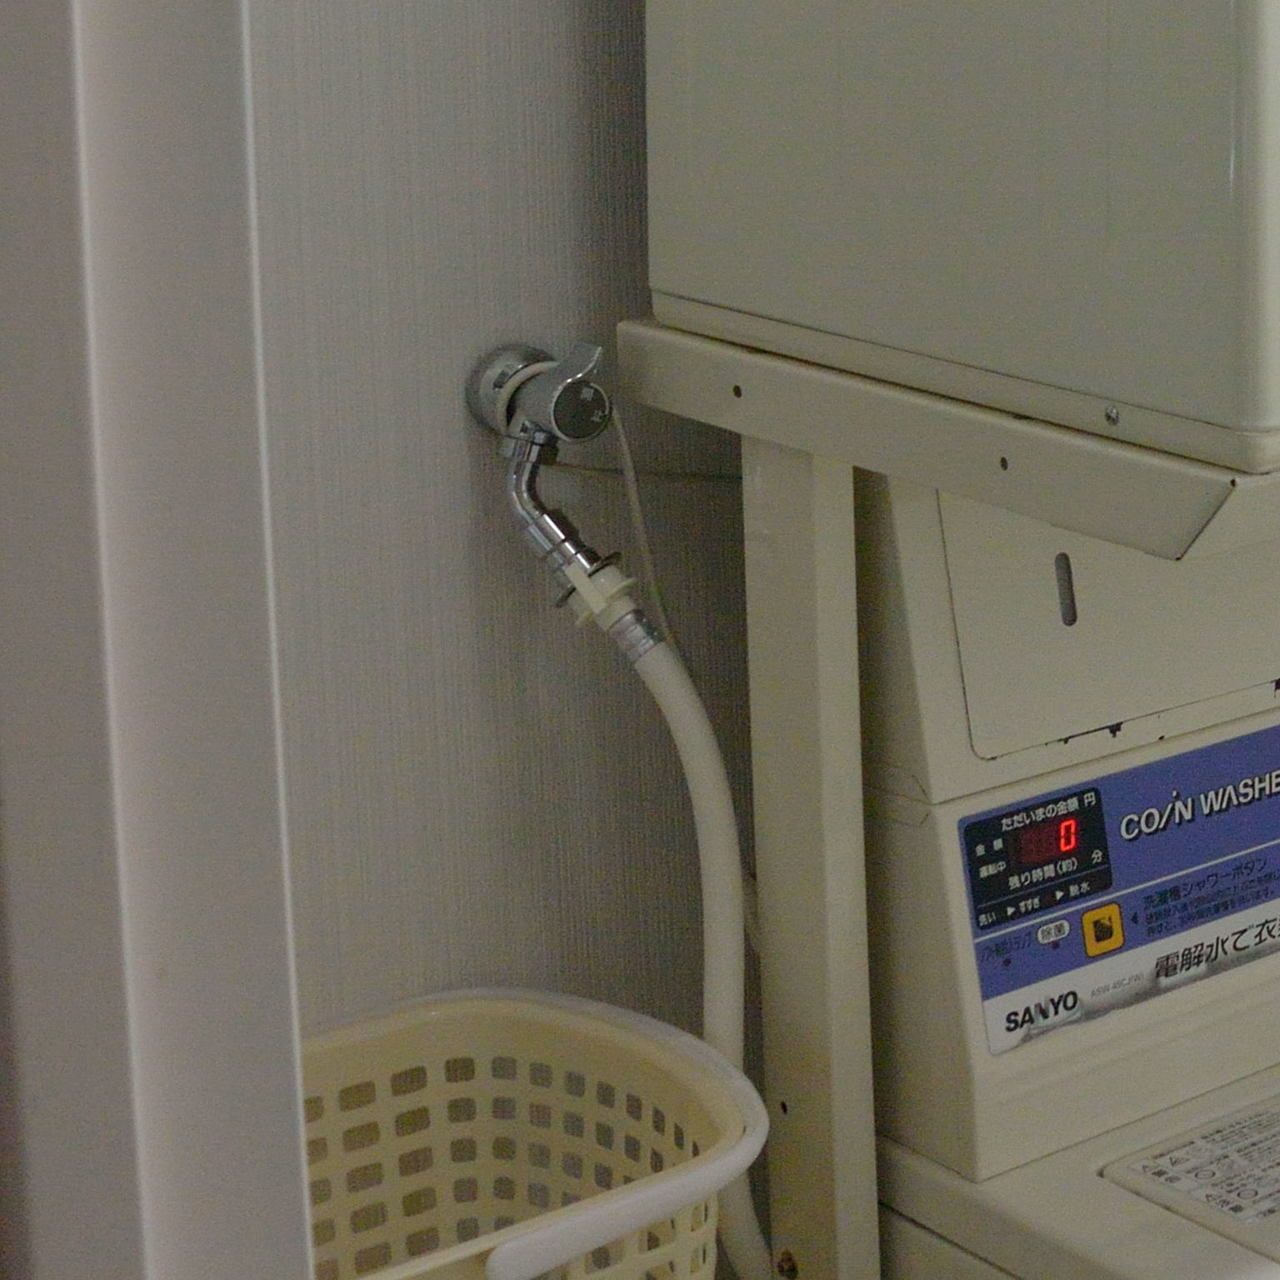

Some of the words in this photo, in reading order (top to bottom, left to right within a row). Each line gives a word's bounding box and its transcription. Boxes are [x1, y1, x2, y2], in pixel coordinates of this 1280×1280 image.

[1001, 798, 1080, 832] ただいまの金額
[1083, 792, 1097, 807] 円
[1060, 818, 1077, 852] 0
[1091, 849, 1104, 864] 分
[1143, 857, 1268, 909] 洗濯槽シャワーボタン
[1019, 895, 1041, 914] すすぎ
[1040, 922, 1067, 941] 除菌
[1005, 990, 1079, 1033] SANYO
